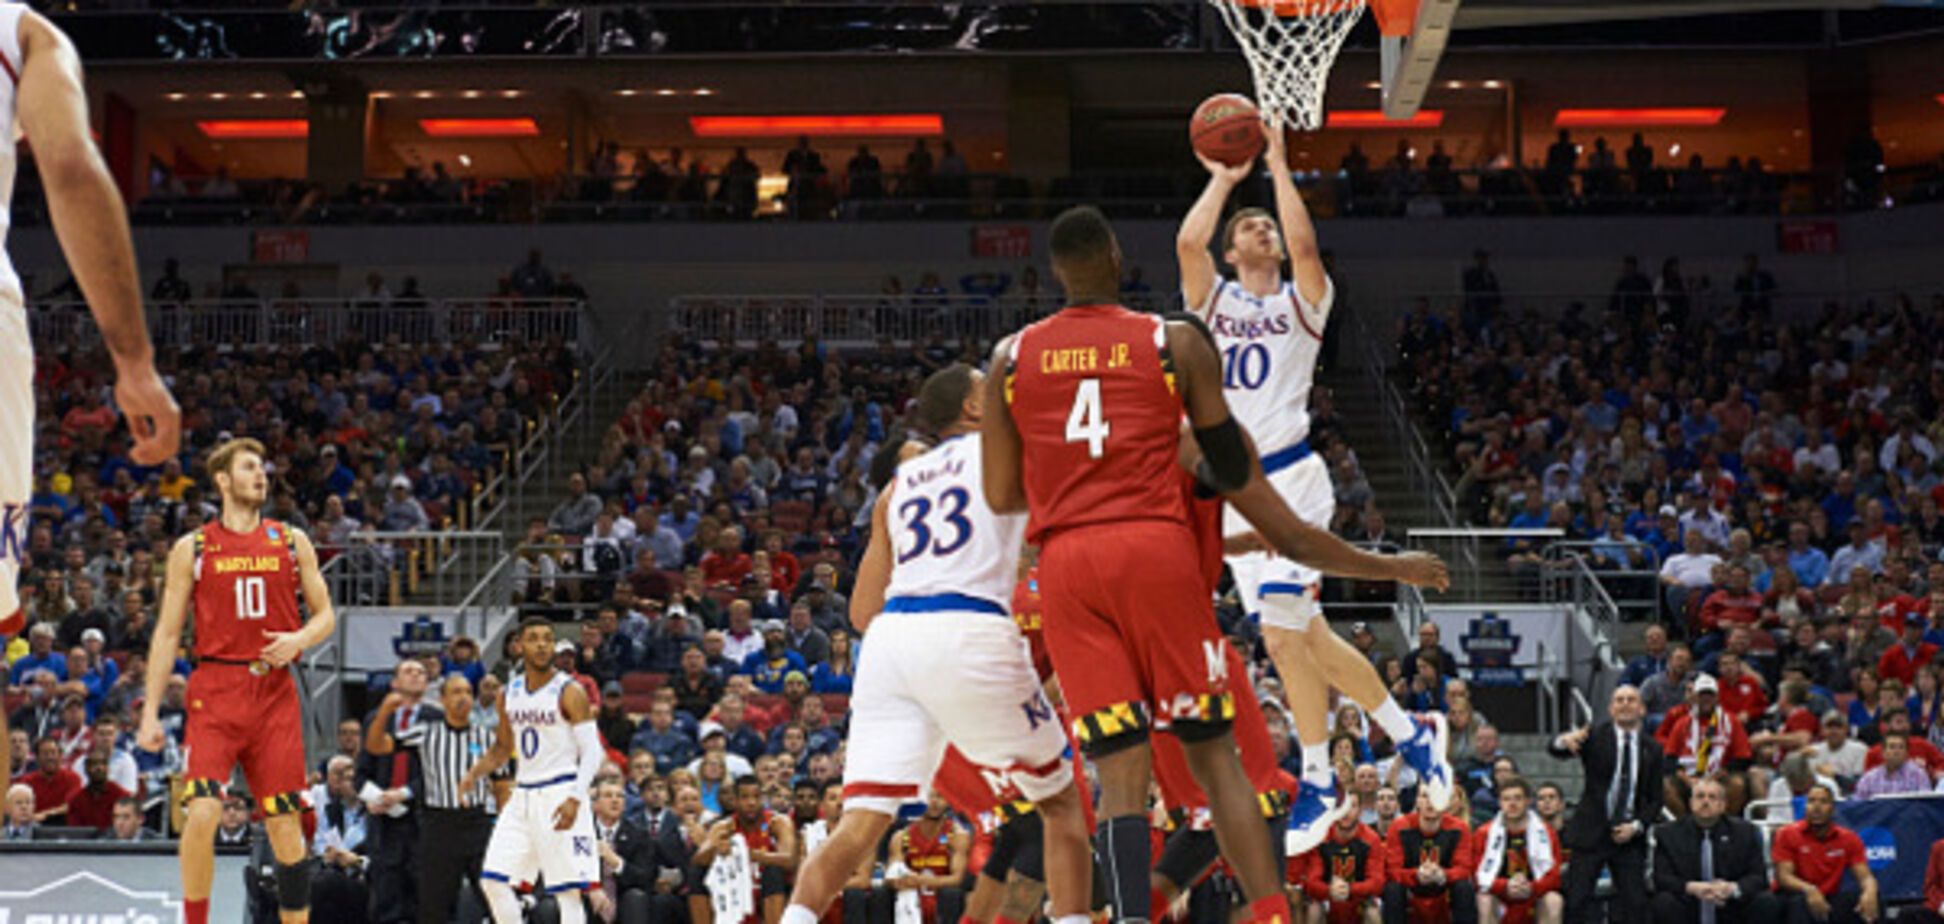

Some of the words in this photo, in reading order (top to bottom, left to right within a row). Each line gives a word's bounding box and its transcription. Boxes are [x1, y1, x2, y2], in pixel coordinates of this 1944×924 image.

[1041, 346, 1098, 374] CARTER
[1107, 342, 1132, 368] JR.
[1222, 343, 1271, 390] 10
[1065, 378, 1110, 459] 4
[898, 486, 973, 565] 33
[235, 575, 267, 621] 10
[521, 726, 539, 760] 0
